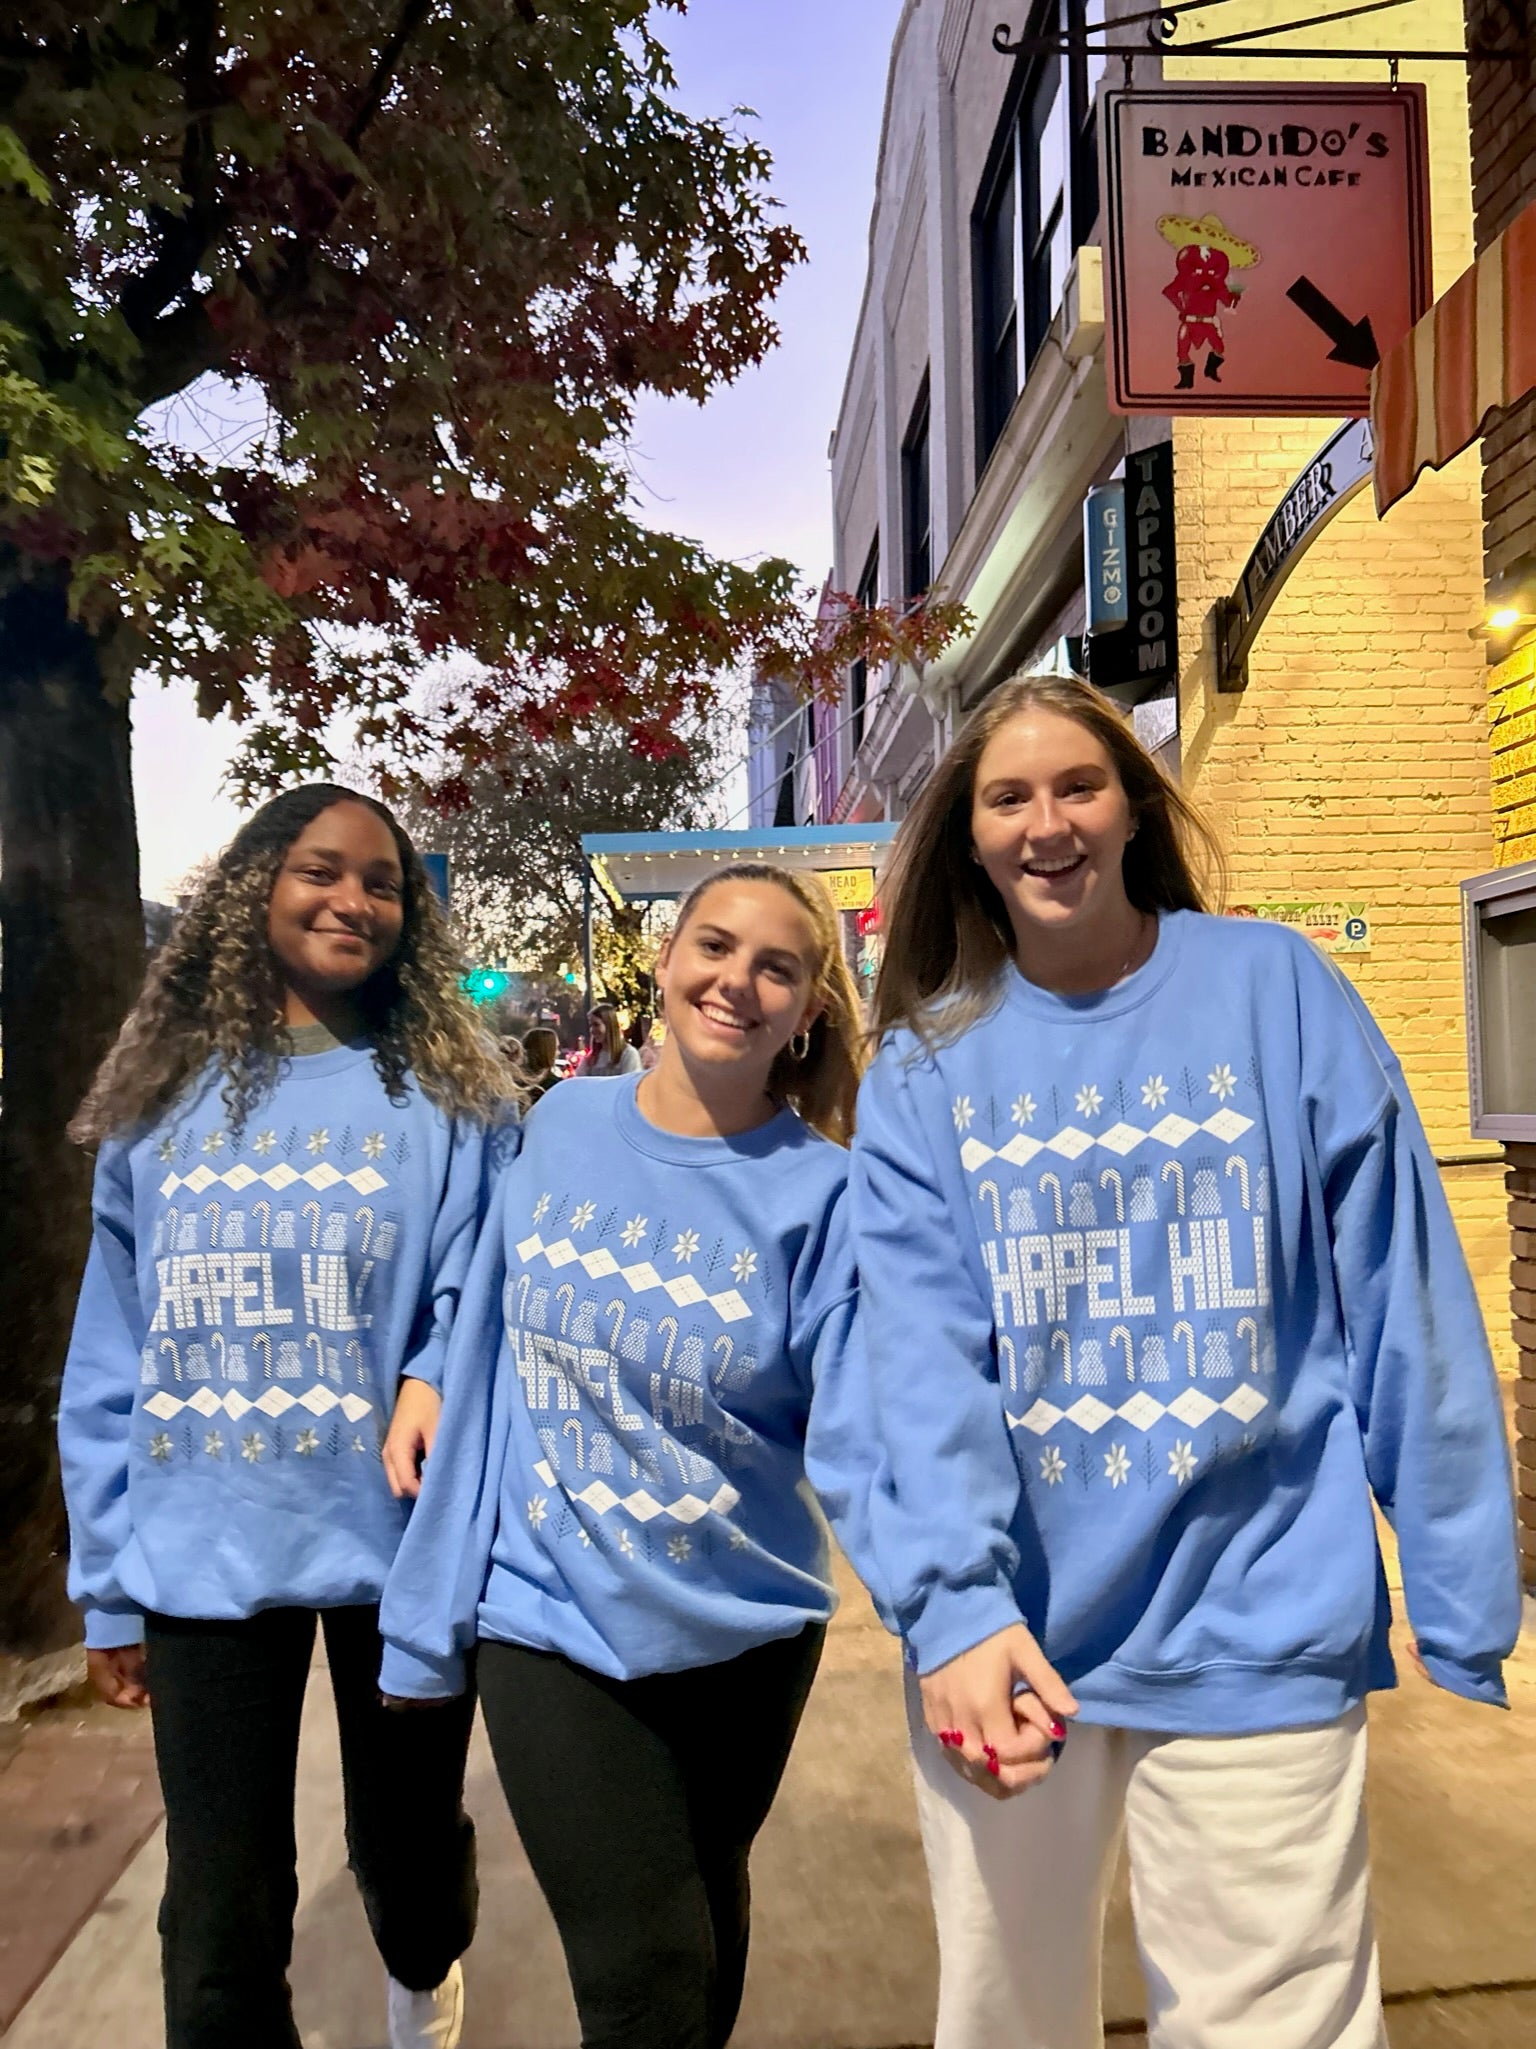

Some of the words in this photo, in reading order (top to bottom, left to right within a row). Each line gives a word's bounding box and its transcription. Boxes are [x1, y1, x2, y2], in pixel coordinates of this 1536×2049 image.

[1295, 166, 1361, 187] CAFE
[1102, 508, 1122, 605] GIZMO
[1135, 452, 1167, 672] TAPROOM
[1252, 462, 1336, 594] AMBER
[150, 1252, 294, 1332] HAPEL
[980, 1228, 1156, 1328] HAPEL
